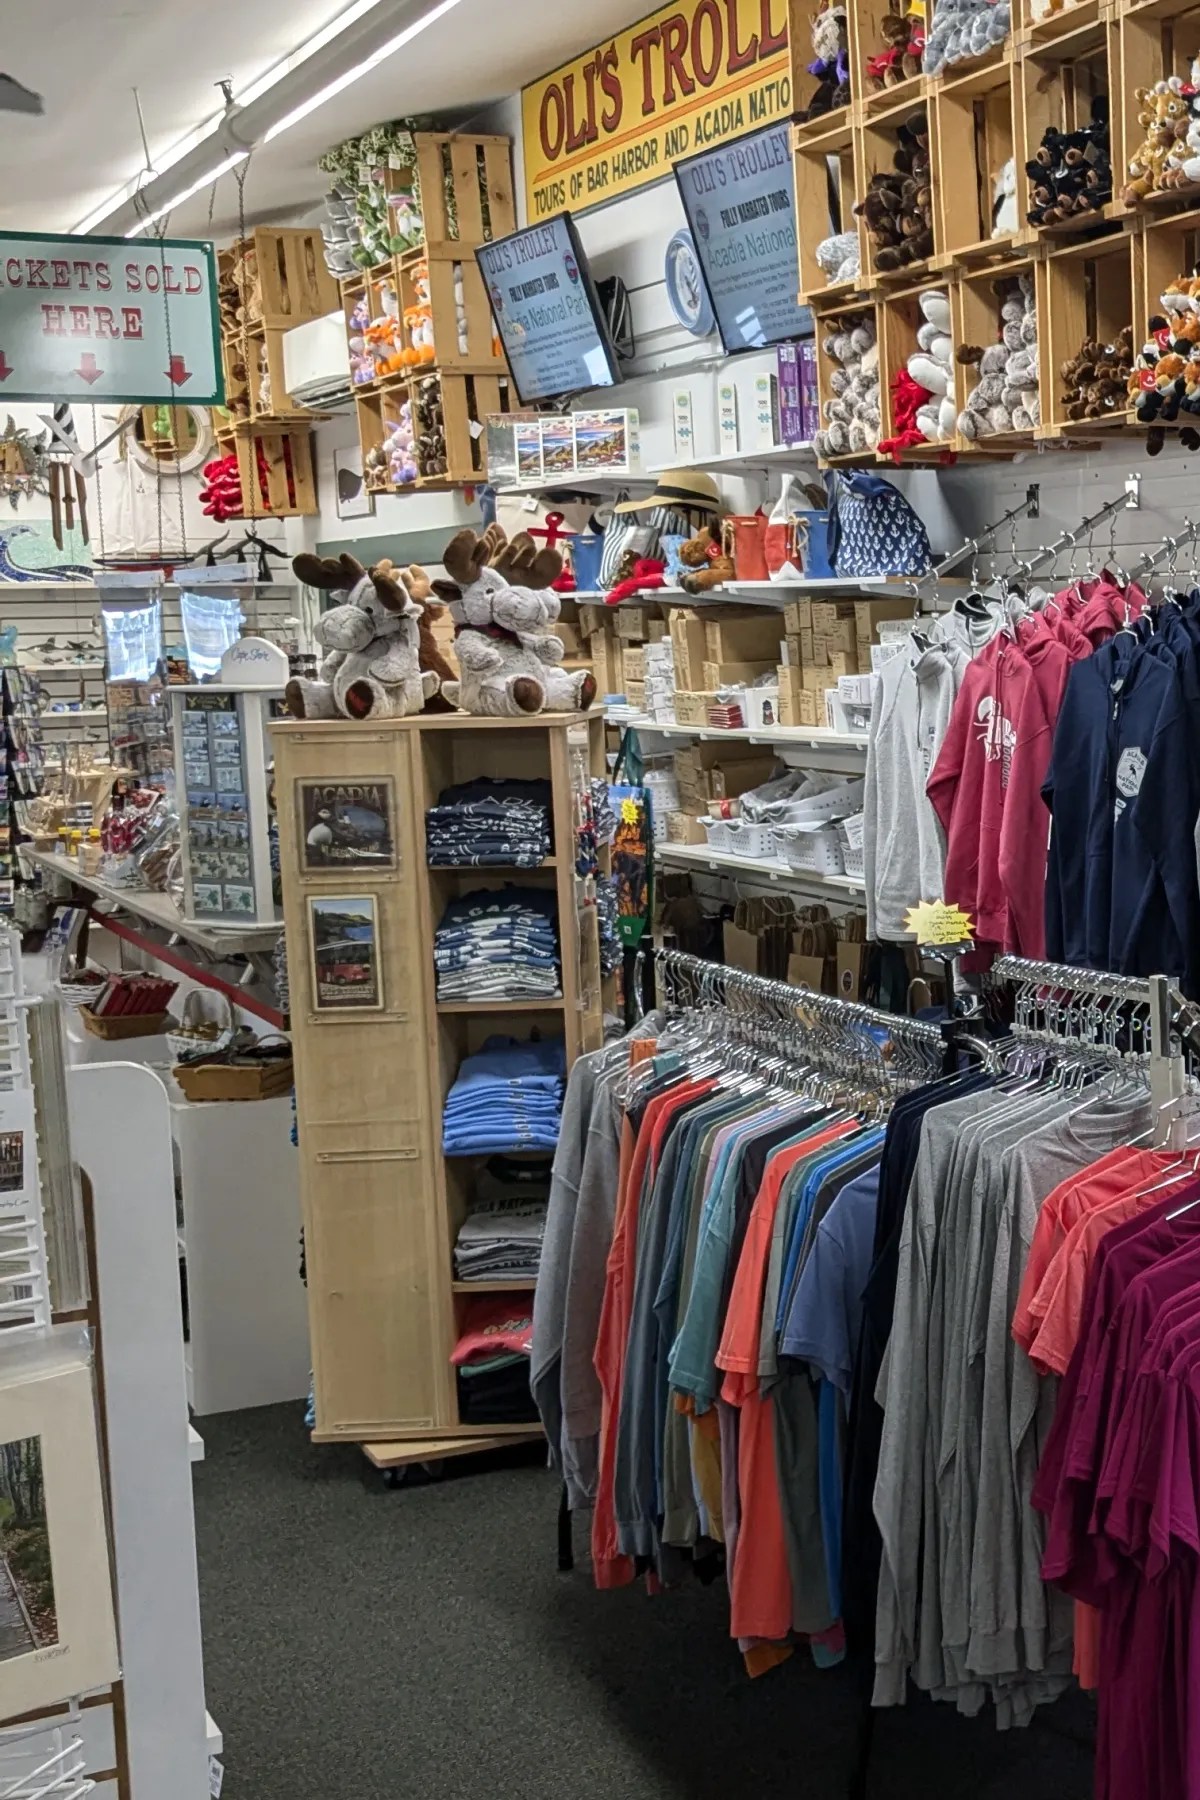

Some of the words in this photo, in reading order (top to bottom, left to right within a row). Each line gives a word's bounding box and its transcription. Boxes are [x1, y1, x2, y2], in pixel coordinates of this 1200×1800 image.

[539, 41, 623, 161] OLI'S
[533, 186, 566, 216] TOURS
[570, 174, 583, 198] OF
[587, 162, 608, 190] BAR
[611, 138, 658, 183] HARBOR
[664, 125, 689, 160] AND
[694, 98, 744, 148] ACADIA
[691, 162, 728, 196] OLI'S
[727, 131, 793, 182] TROLLEY
[770, 189, 791, 212] TOURS
[485, 243, 513, 275] OLI'S
[511, 225, 559, 266] TROLLEY
[708, 239, 745, 271] Acadia
[749, 217, 797, 261] National
[125, 264, 203, 294] SOLD
[41, 304, 144, 340] HERE
[529, 297, 569, 328] National
[312, 786, 382, 810] ACADIA
